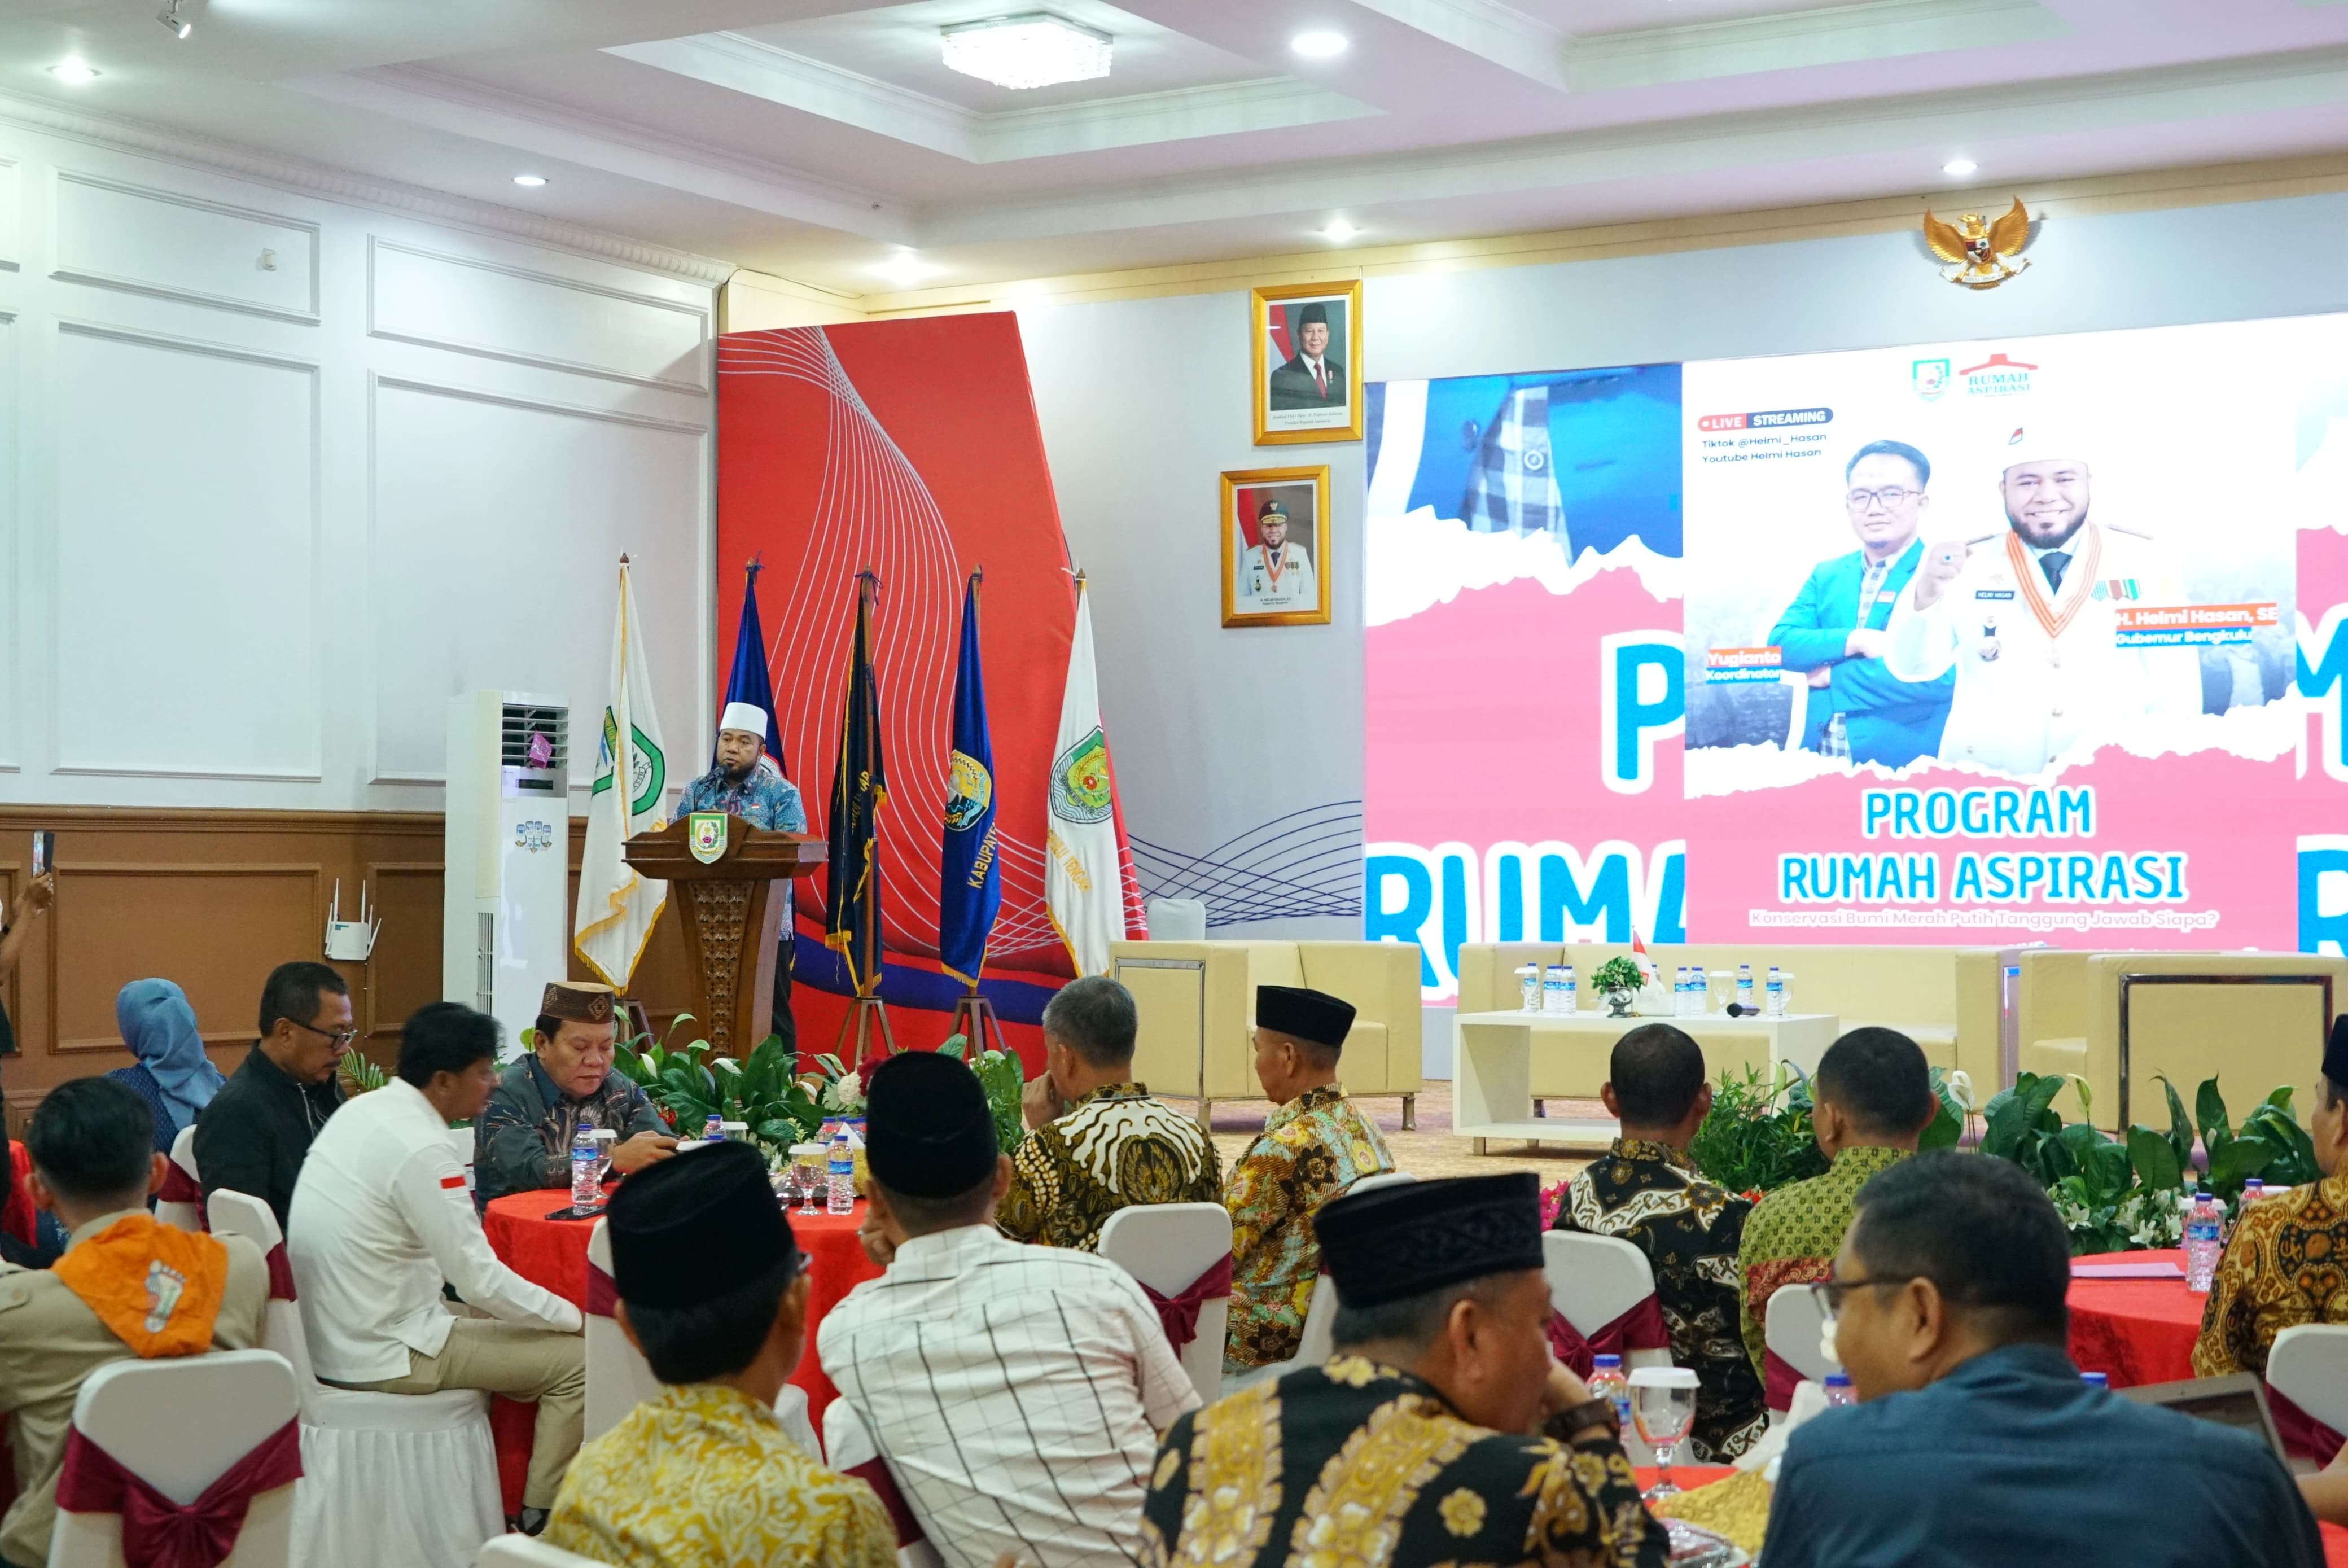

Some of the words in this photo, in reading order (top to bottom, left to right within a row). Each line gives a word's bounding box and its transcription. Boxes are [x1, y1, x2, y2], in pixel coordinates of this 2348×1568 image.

[1969, 373, 2029, 385] RUMAH
[1968, 384, 2030, 394] ASPIRASI
[1712, 417, 1743, 429] LIVE
[1753, 410, 1826, 426] STREAMING
[1702, 439, 1734, 449] Tiktok
[1702, 455, 1749, 463] Youtube
[1751, 450, 1782, 460] Helmi
[1785, 449, 1821, 459] Hasan
[2136, 610, 2188, 625] Helmi
[2191, 608, 2254, 624] Hasan,
[2256, 607, 2278, 621] SE
[2116, 633, 2184, 645] Gubernur
[2184, 629, 2252, 645] Bengkulu
[1708, 651, 1782, 667] Yugianto
[1867, 789, 2090, 835] PROGRAM
[1782, 856, 1935, 899] RUMAH
[1955, 856, 2183, 899] ASPIRASI
[1753, 912, 1842, 924] Konservasi
[1846, 913, 1890, 924] Bumi
[1893, 912, 1946, 924] Merah
[1951, 912, 1992, 924] Putih
[1998, 913, 2088, 928] Tanggung
[2092, 912, 2152, 925] Jawab
[2157, 912, 2216, 928] Siapa?
